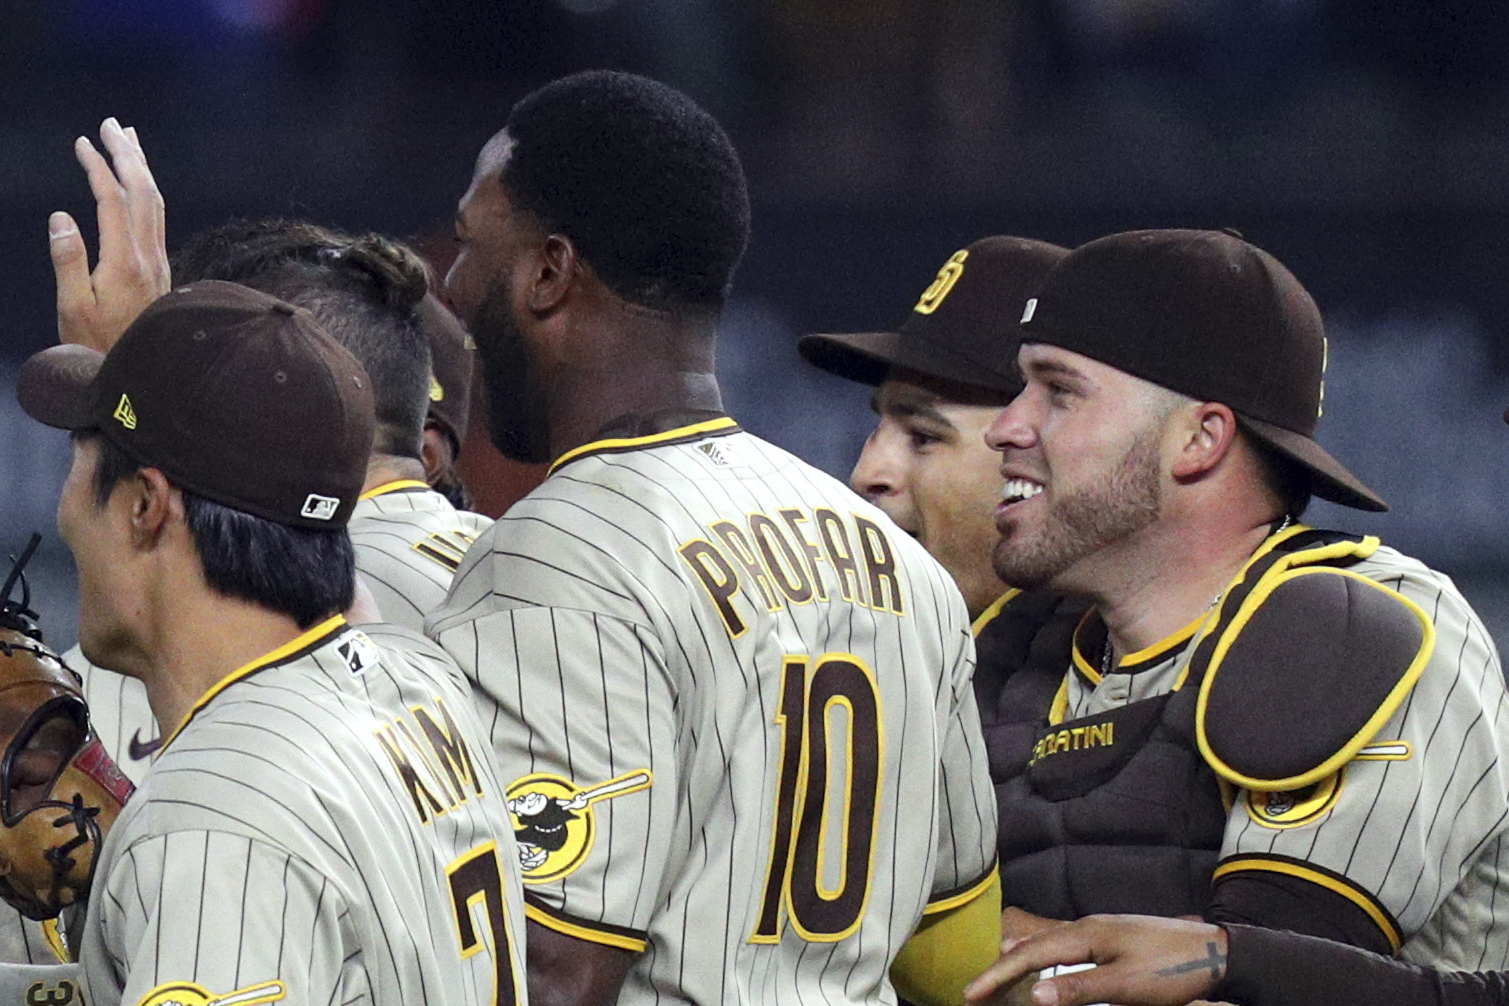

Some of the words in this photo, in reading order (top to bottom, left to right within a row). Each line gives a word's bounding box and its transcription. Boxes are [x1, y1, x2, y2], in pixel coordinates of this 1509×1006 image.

[677, 506, 905, 640] PROFAR
[373, 696, 485, 826] KIM
[746, 651, 884, 945] 10
